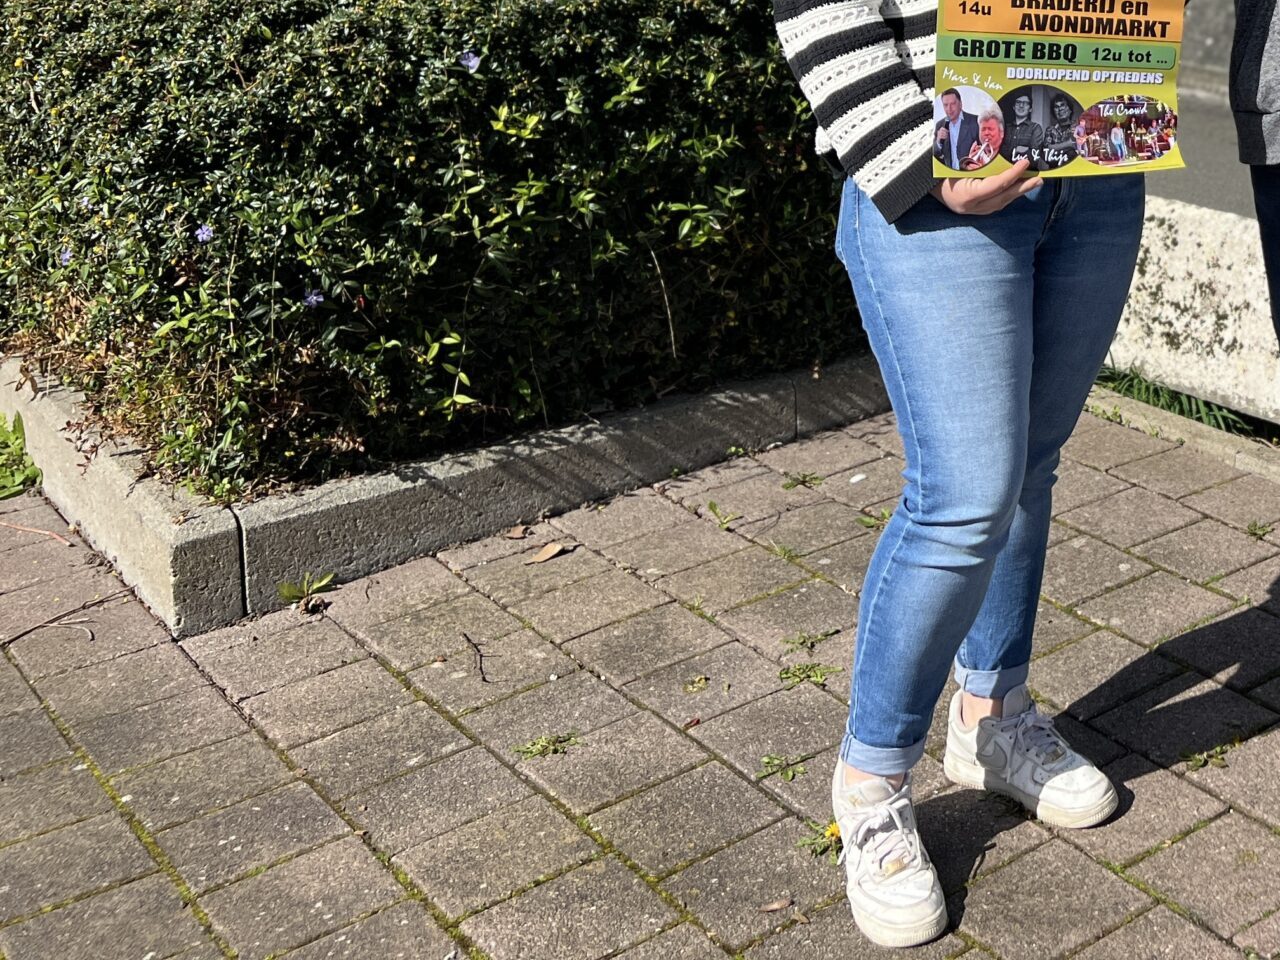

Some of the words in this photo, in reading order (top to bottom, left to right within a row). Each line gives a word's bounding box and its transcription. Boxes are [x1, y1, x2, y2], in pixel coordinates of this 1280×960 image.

[958, 0, 992, 16] 14u
[1120, 0, 1149, 15] en
[1018, 13, 1170, 38] AVONDMARKT
[953, 38, 1026, 59] GROTE
[1031, 43, 1077, 64] BBQ
[1091, 47, 1122, 62] 12u
[1128, 49, 1152, 63] tot
[942, 67, 968, 84] Marc
[973, 73, 982, 85] &
[984, 76, 1003, 90] Jan
[1006, 67, 1090, 81] DOORLOPEND
[1092, 70, 1163, 84] OPTREDENS
[1098, 103, 1114, 117] The
[1116, 102, 1147, 116] Crowd
[1011, 148, 1028, 161] Luc
[1031, 149, 1041, 160] &
[1043, 148, 1068, 165] Thijs
